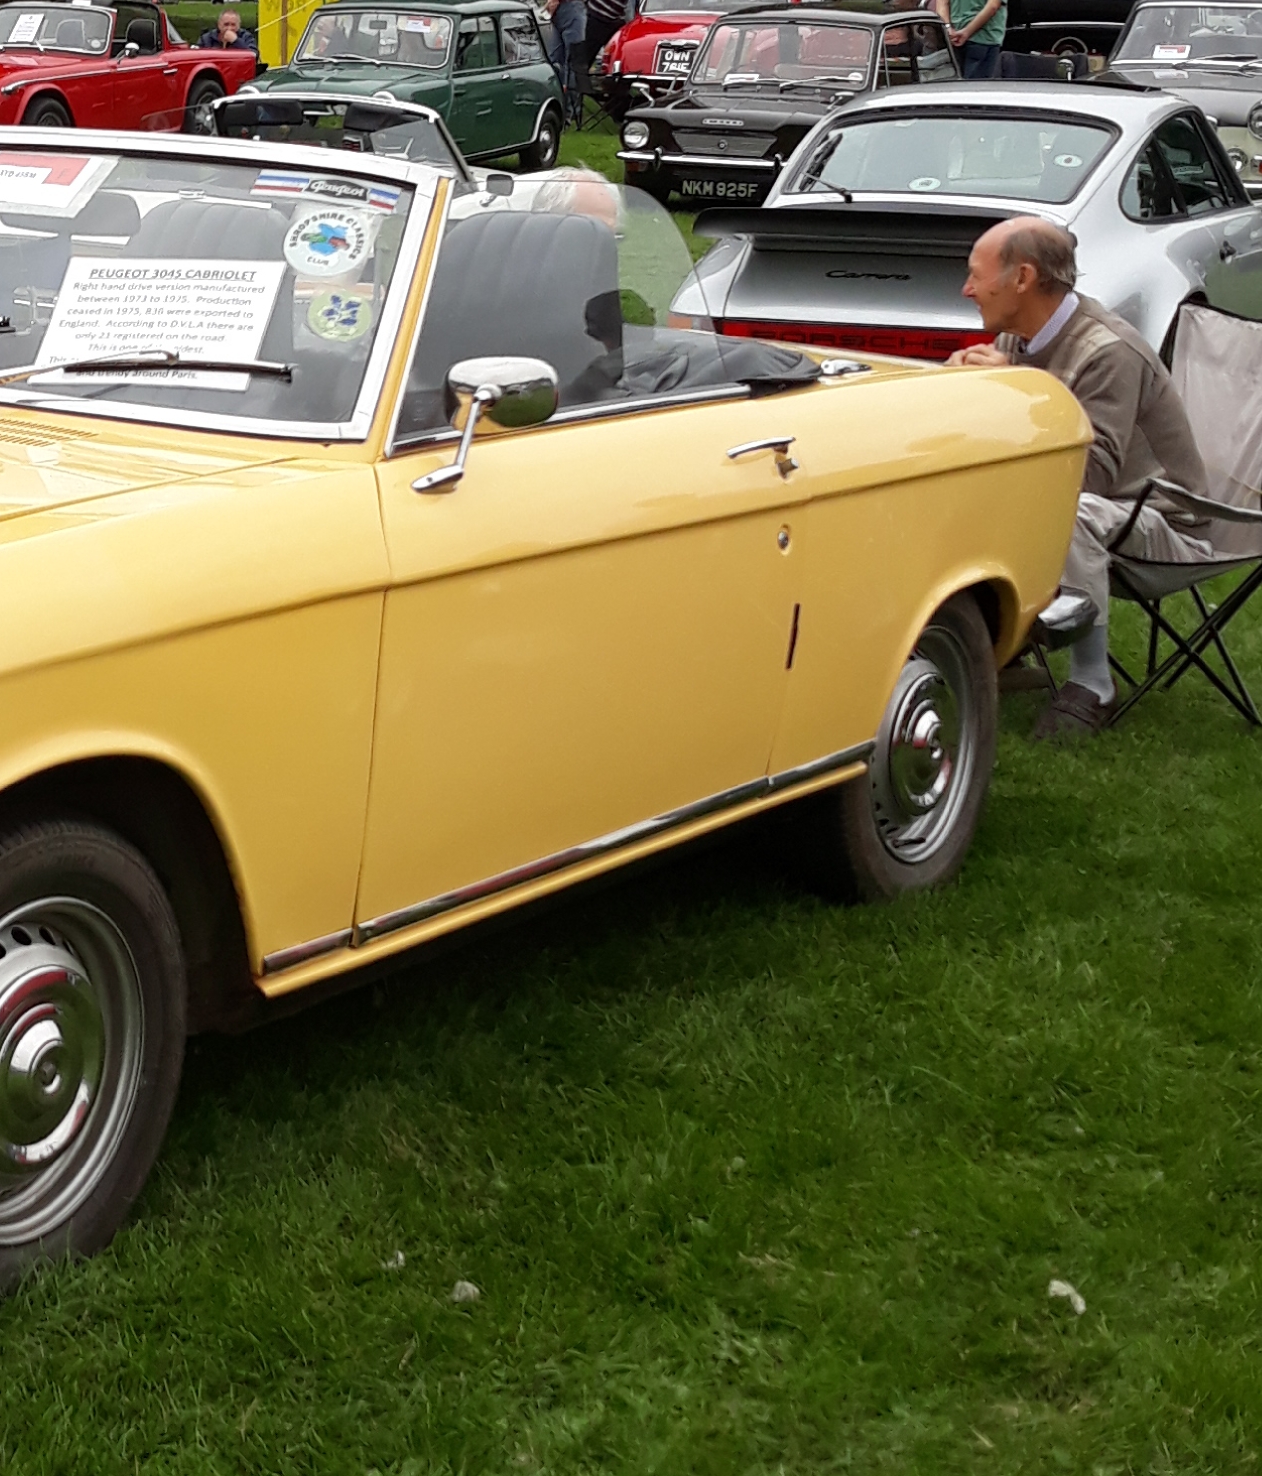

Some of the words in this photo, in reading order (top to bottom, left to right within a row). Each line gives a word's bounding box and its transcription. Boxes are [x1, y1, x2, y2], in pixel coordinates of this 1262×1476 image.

[664, 50, 691, 61] OWN
[310, 180, 366, 198] Peugeot
[682, 180, 714, 195] NKM
[716, 182, 758, 197] 925F
[289, 211, 346, 248] SHROPSHIRE
[345, 217, 366, 260] CLASSICS
[307, 256, 329, 266] CLUB
[89, 268, 150, 279] PEUGEOT
[151, 269, 182, 279] 304S
[185, 269, 258, 281] CABRIOLET
[824, 269, 912, 281] Carrera
[73, 282, 99, 291] Right
[101, 283, 126, 291] hand
[127, 283, 153, 291] drive
[155, 283, 191, 291] version
[193, 284, 266, 294] manufactured
[77, 294, 120, 303] between
[149, 295, 160, 303] to
[195, 295, 252, 306] Production
[66, 307, 102, 316] ceased
[103, 307, 114, 316] in
[166, 308, 191, 316] were
[193, 309, 242, 319] exported
[242, 311, 254, 319] to
[105, 319, 155, 329] According
[156, 320, 168, 328] to
[206, 321, 235, 330] there
[236, 324, 254, 332] are
[74, 332, 97, 341] only
[113, 332, 164, 341] registered
[165, 333, 179, 341] on
[181, 333, 199, 341] the
[749, 329, 961, 351] PORSCHE
[88, 343, 107, 352] This
[109, 344, 118, 352] is
[131, 370, 169, 379] around
